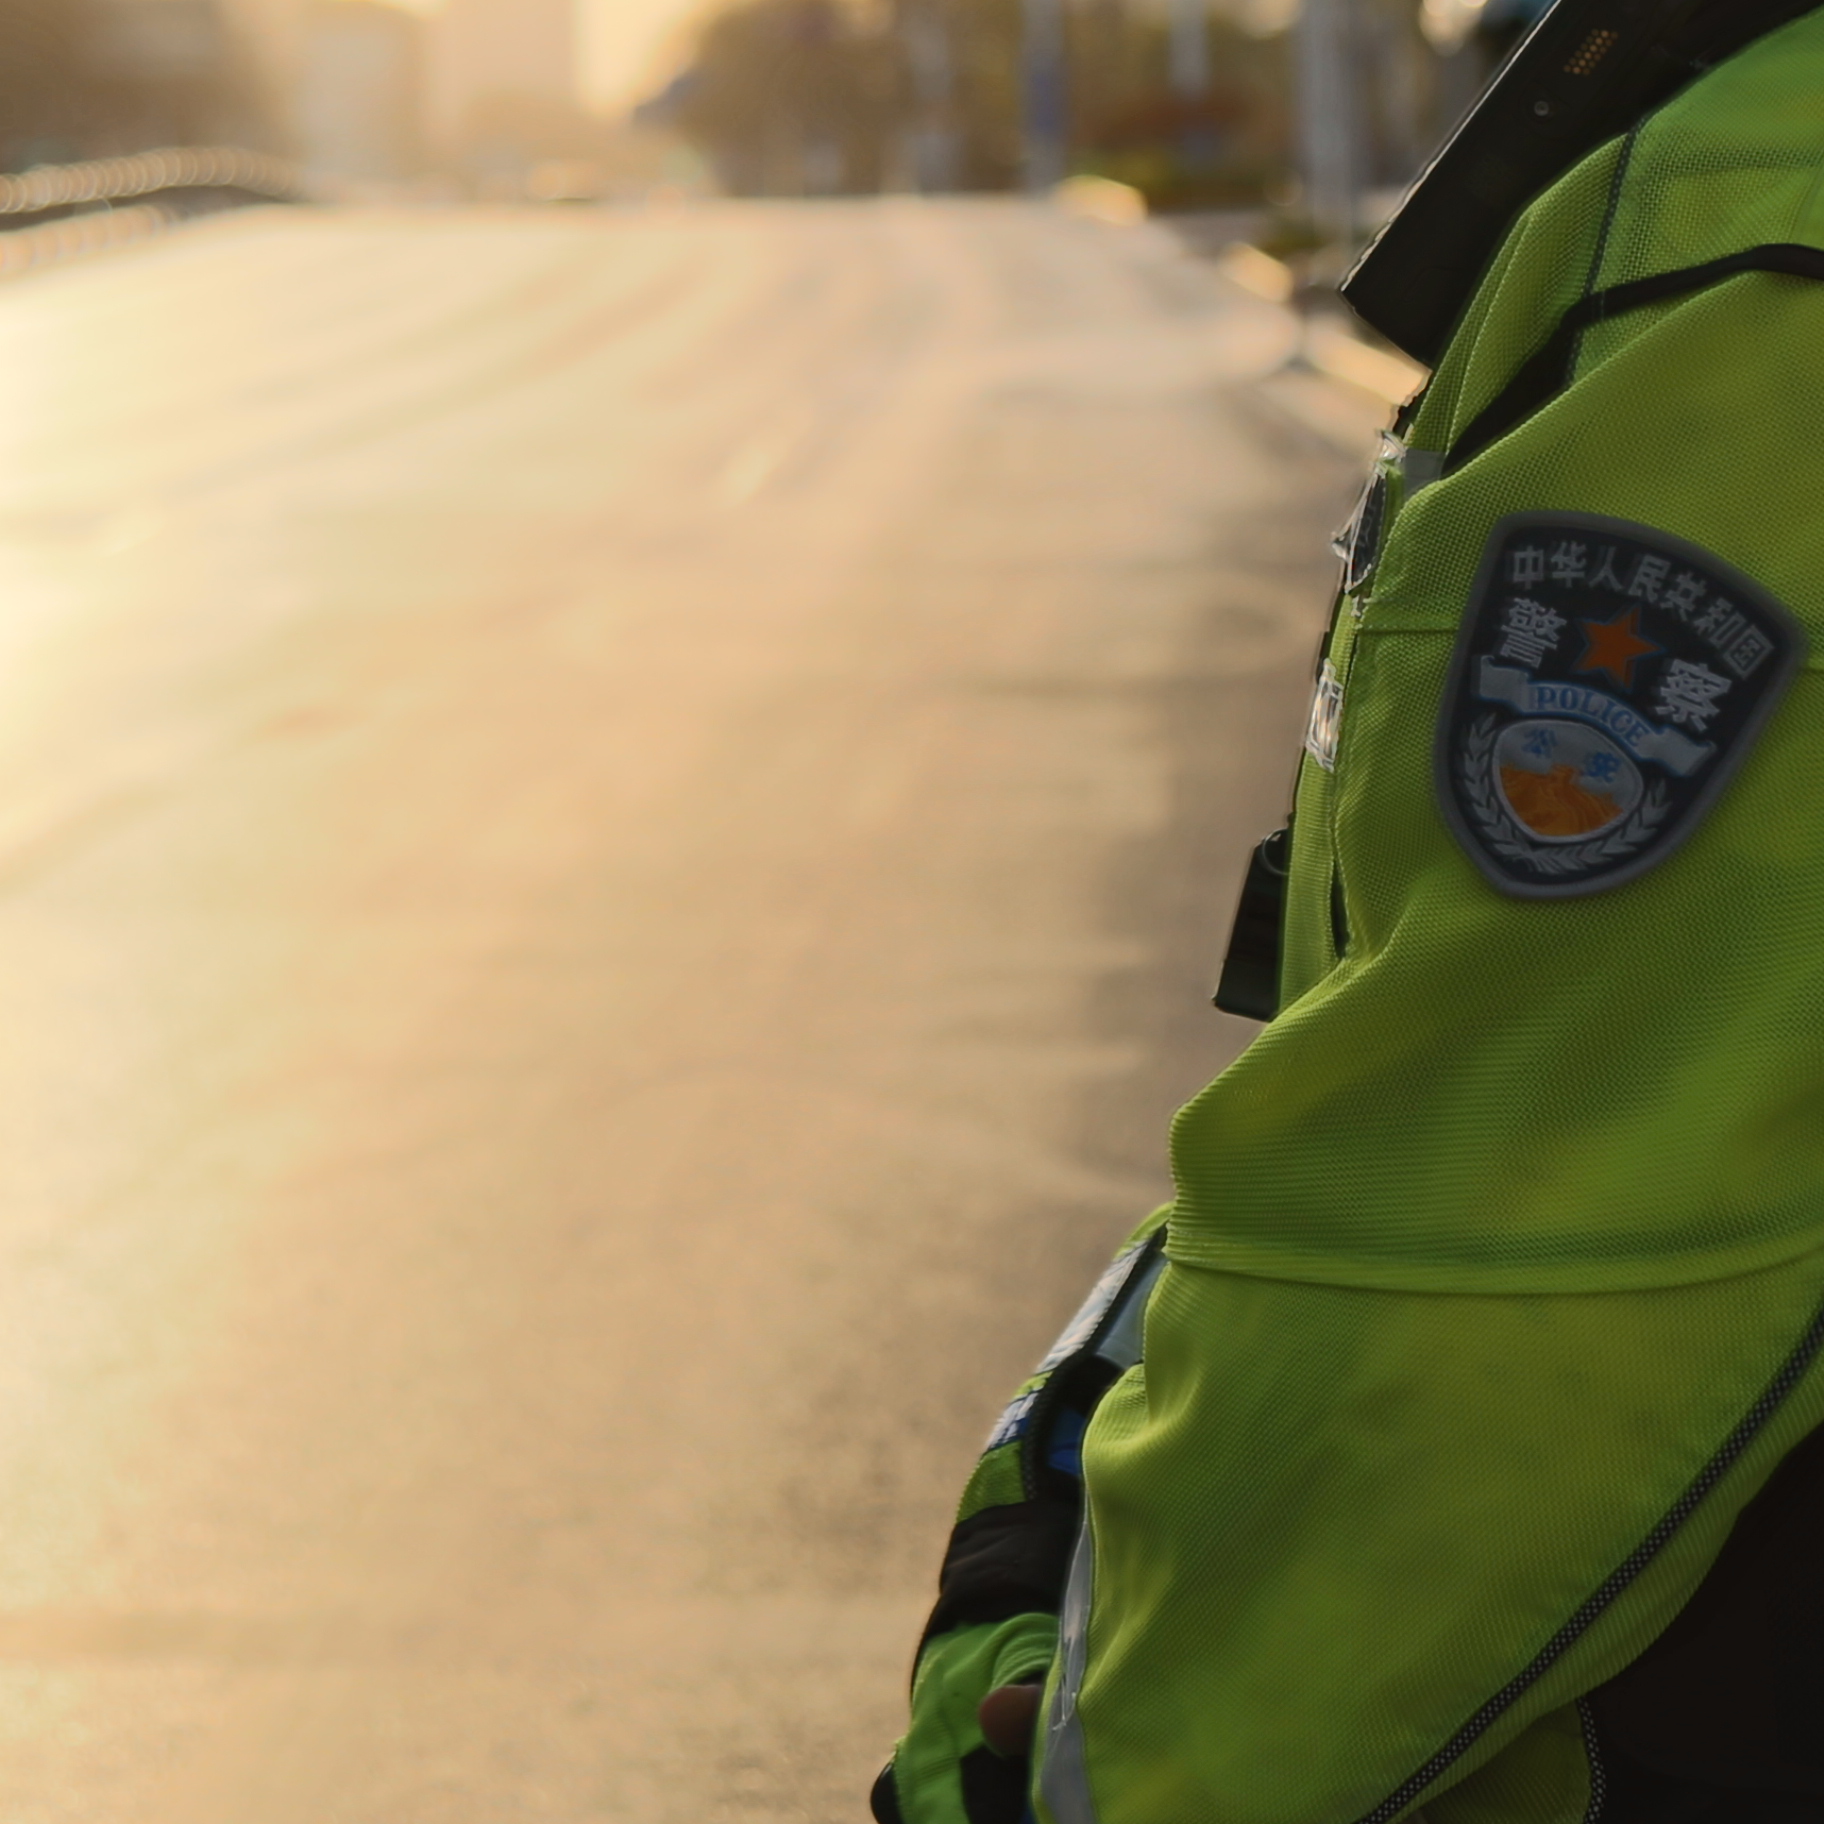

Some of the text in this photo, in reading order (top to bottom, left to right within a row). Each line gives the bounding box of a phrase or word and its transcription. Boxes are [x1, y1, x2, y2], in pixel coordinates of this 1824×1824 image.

[1509, 539, 1776, 682] 中华人民共和国
[1533, 683, 1657, 748] POLICE
